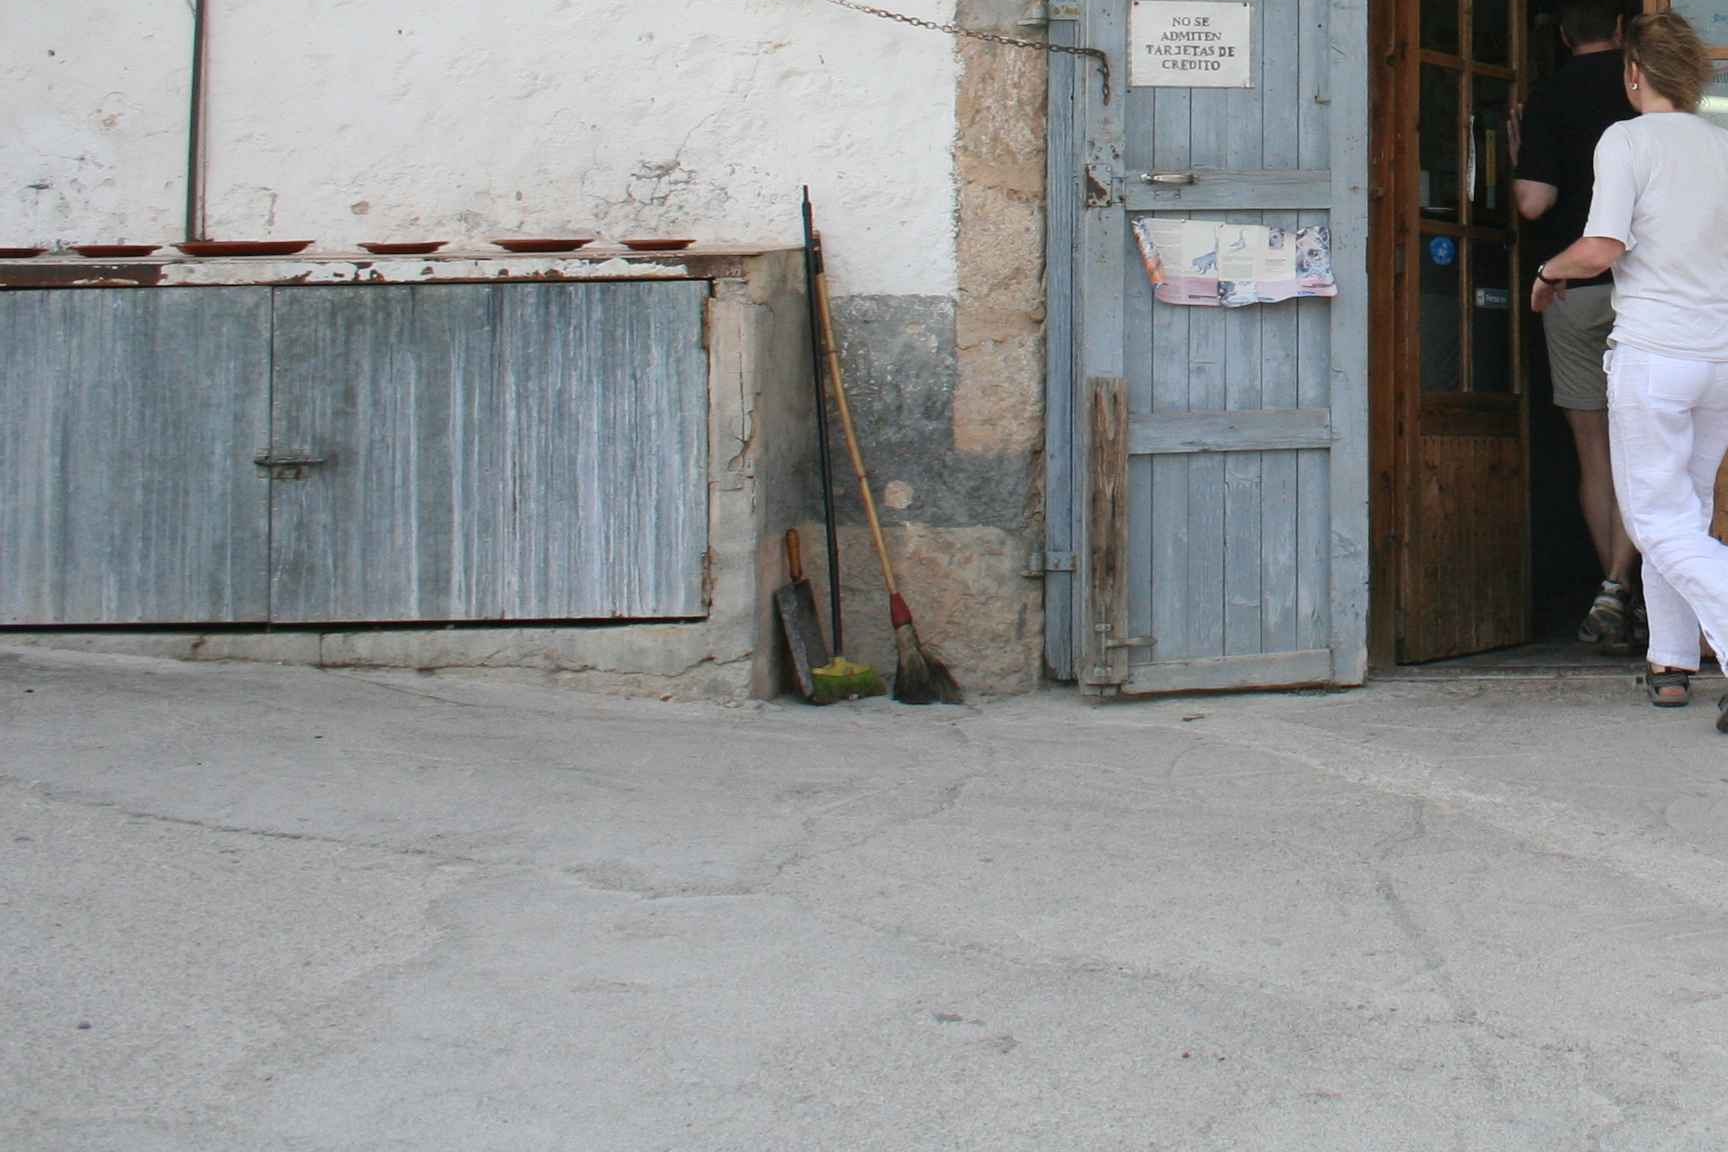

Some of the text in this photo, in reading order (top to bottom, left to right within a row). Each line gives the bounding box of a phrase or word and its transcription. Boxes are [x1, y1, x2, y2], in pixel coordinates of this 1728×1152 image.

[1172, 16, 1210, 27] NO SE
[1161, 31, 1222, 42] ADMITEN
[1145, 44, 1236, 58] TARJETAS DE
